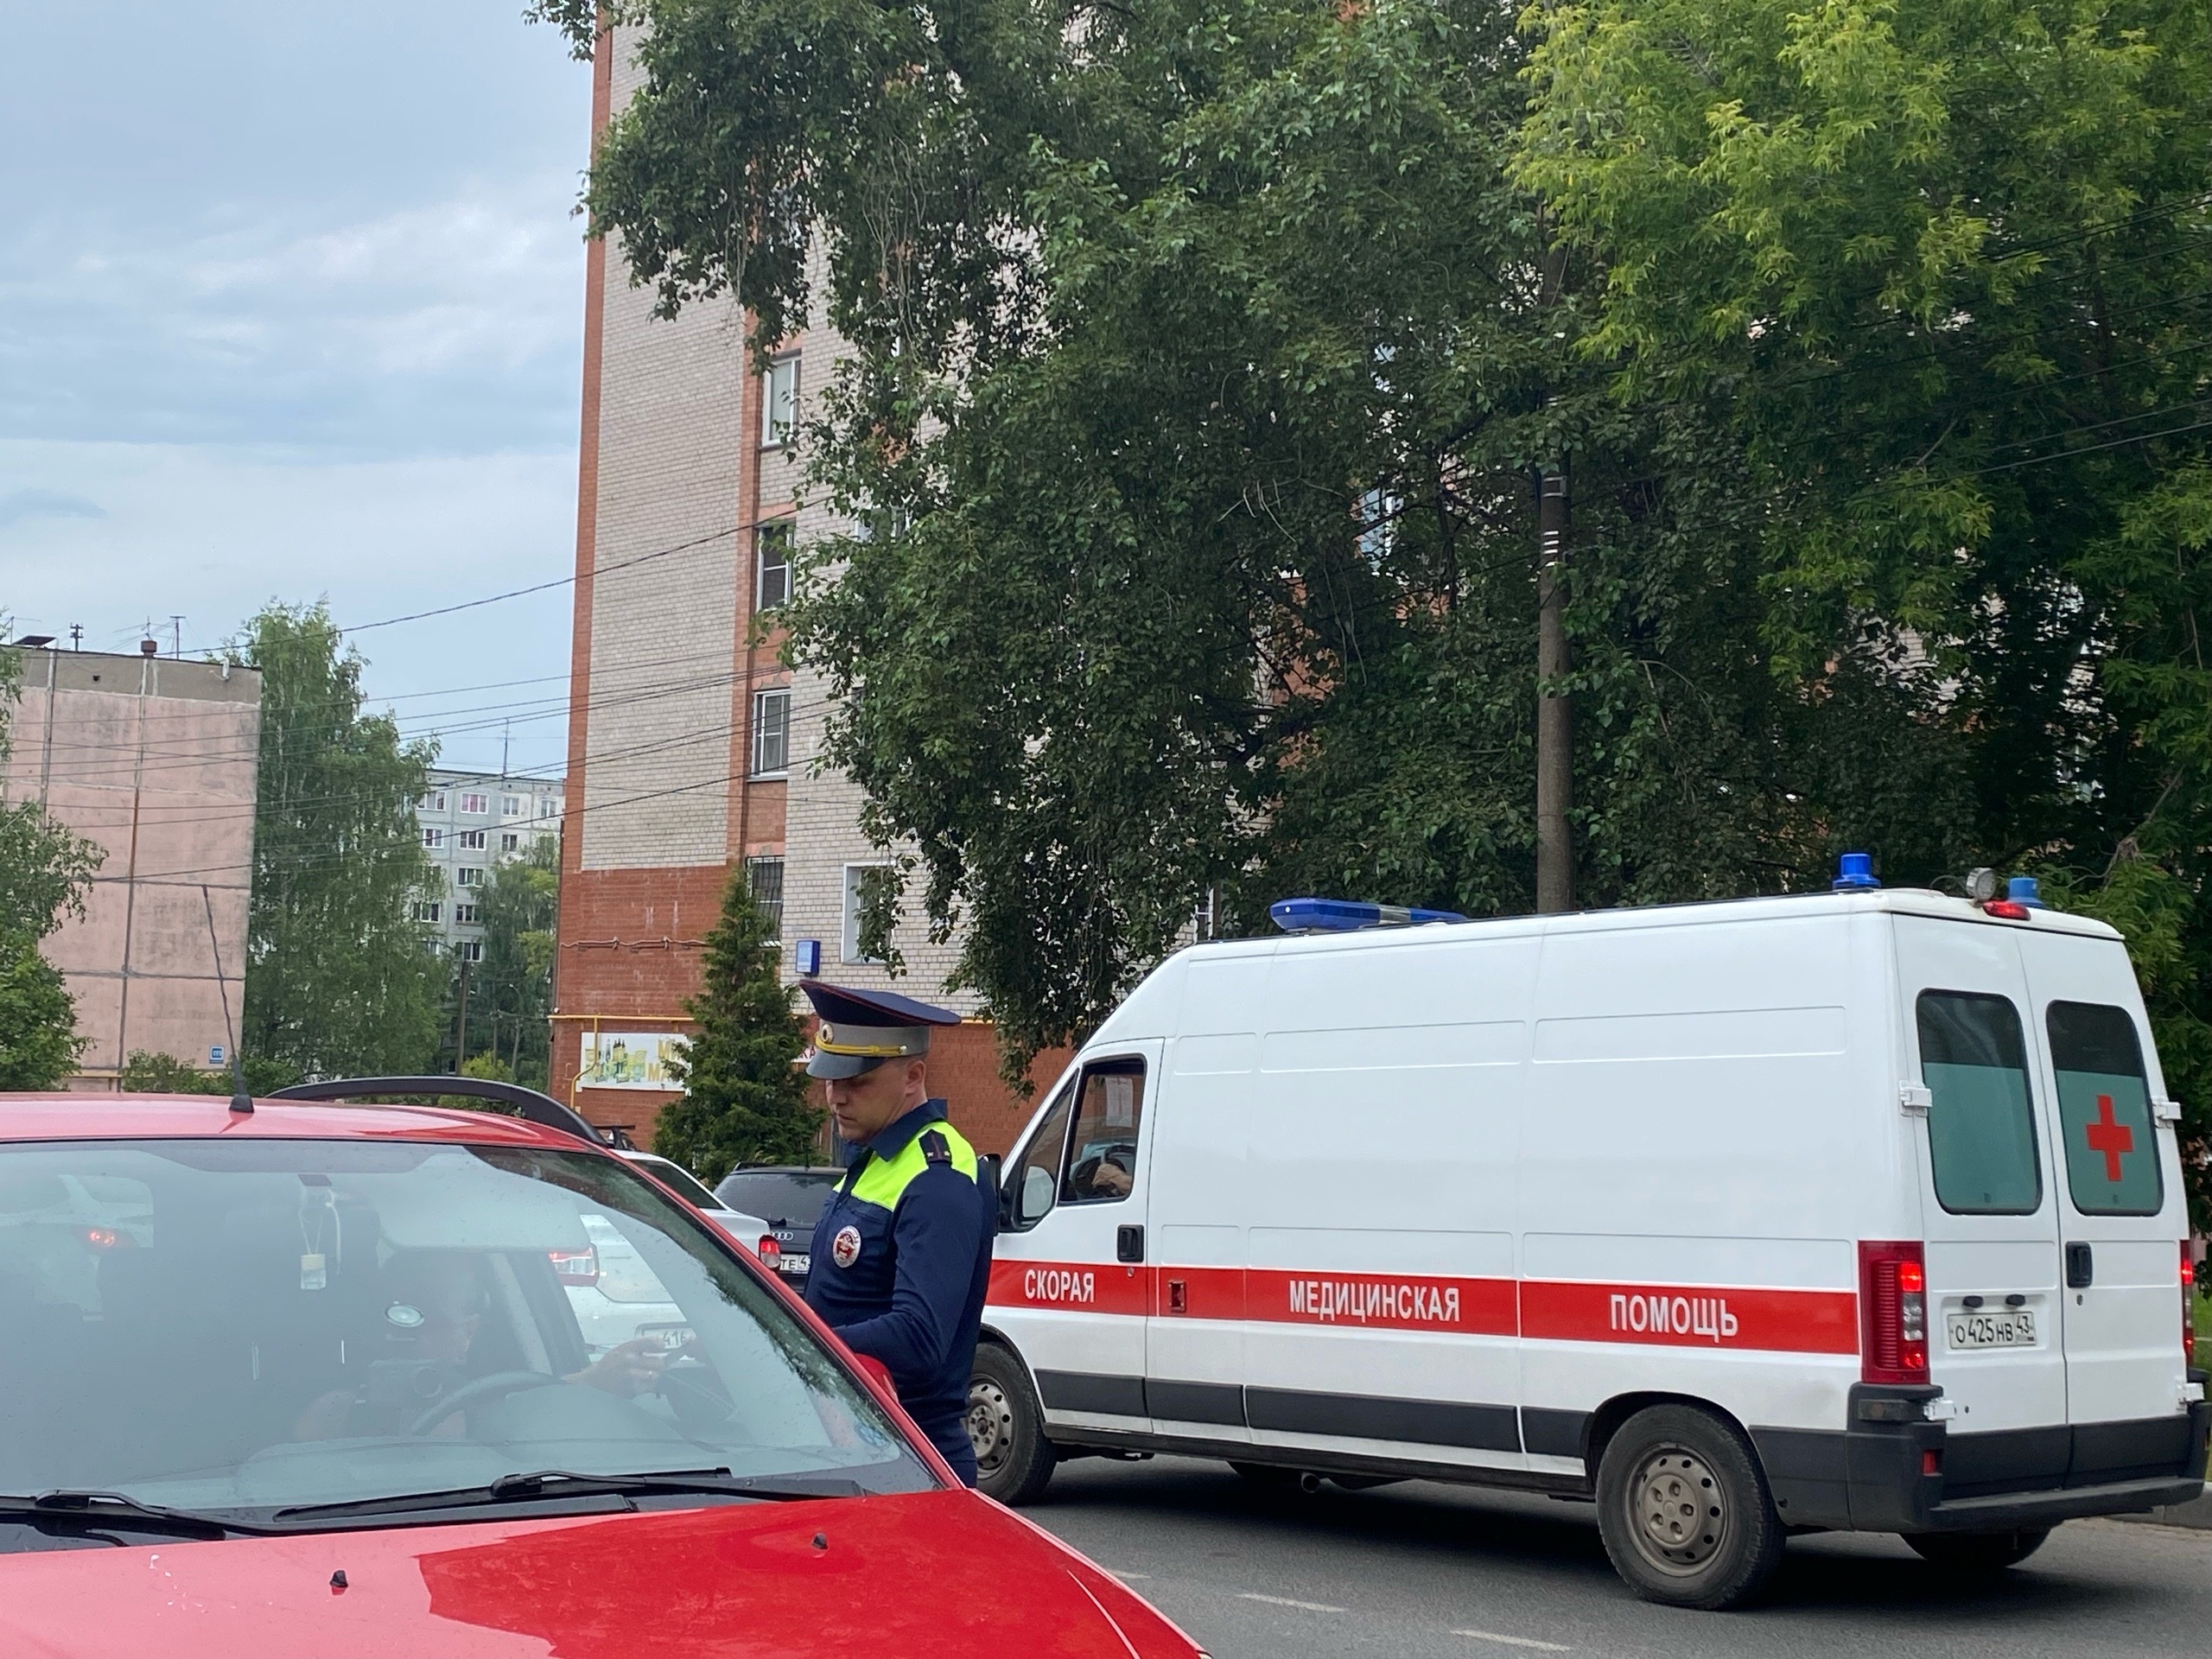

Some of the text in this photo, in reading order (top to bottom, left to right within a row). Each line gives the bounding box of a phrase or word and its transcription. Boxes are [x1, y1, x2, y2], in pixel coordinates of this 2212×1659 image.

[1025, 1268, 1738, 1343] СКОРАЯ МЕДИЦИНСКАЯ ПОМОЩЬ
